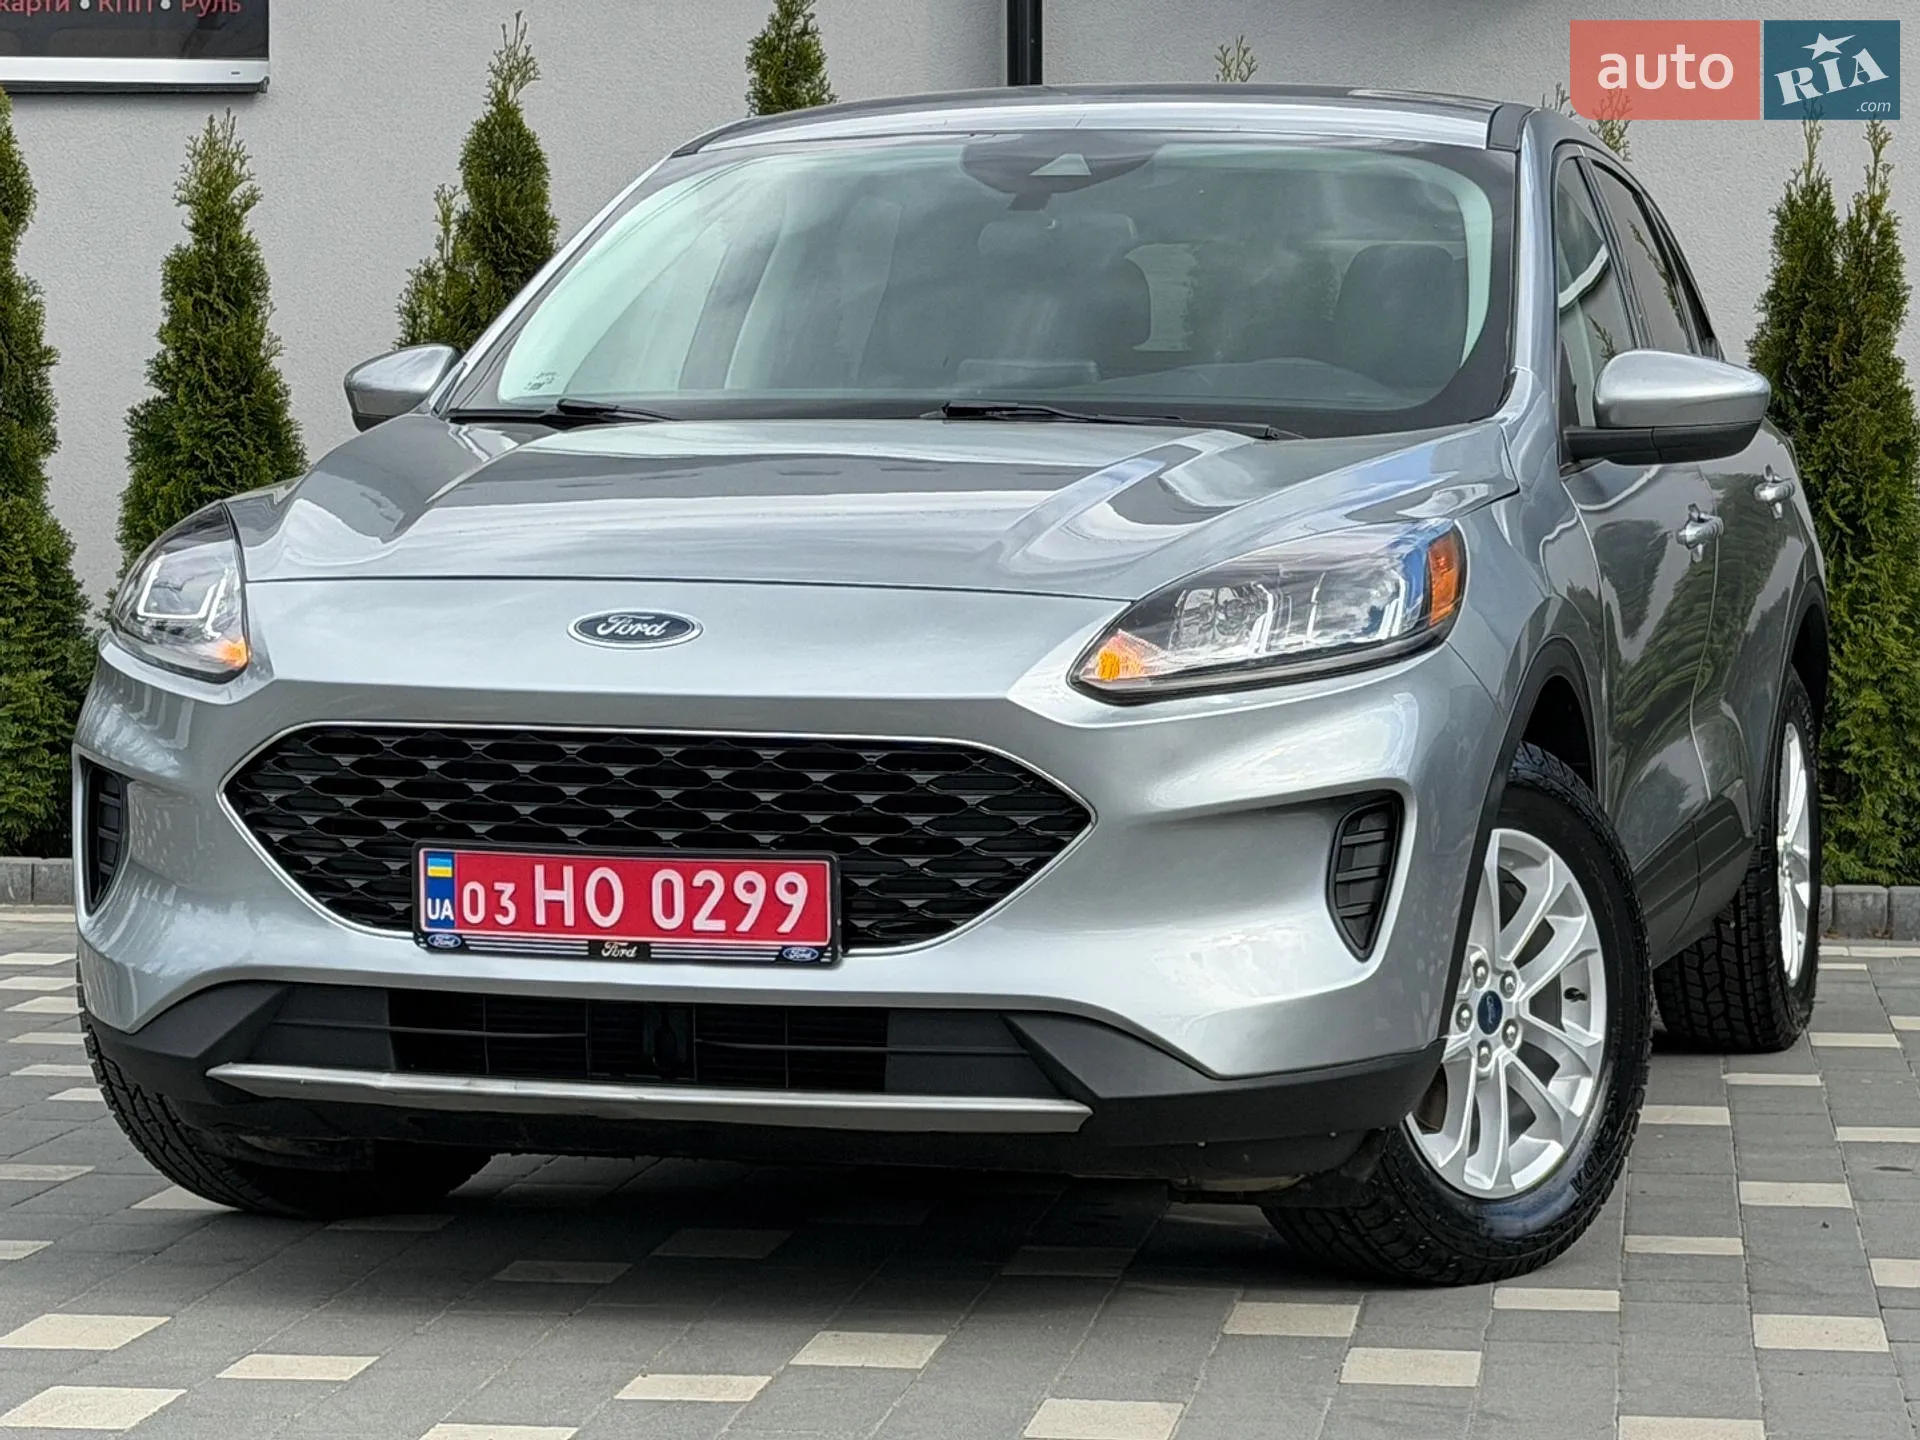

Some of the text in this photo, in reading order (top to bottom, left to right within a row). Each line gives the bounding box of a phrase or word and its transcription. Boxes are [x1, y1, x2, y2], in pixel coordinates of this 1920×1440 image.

[181, 0, 242, 17] Руль
[596, 614, 671, 636] Ford
[427, 898, 454, 921] UA
[462, 864, 810, 934] 03 HO 0299
[601, 941, 638, 958] Ford
